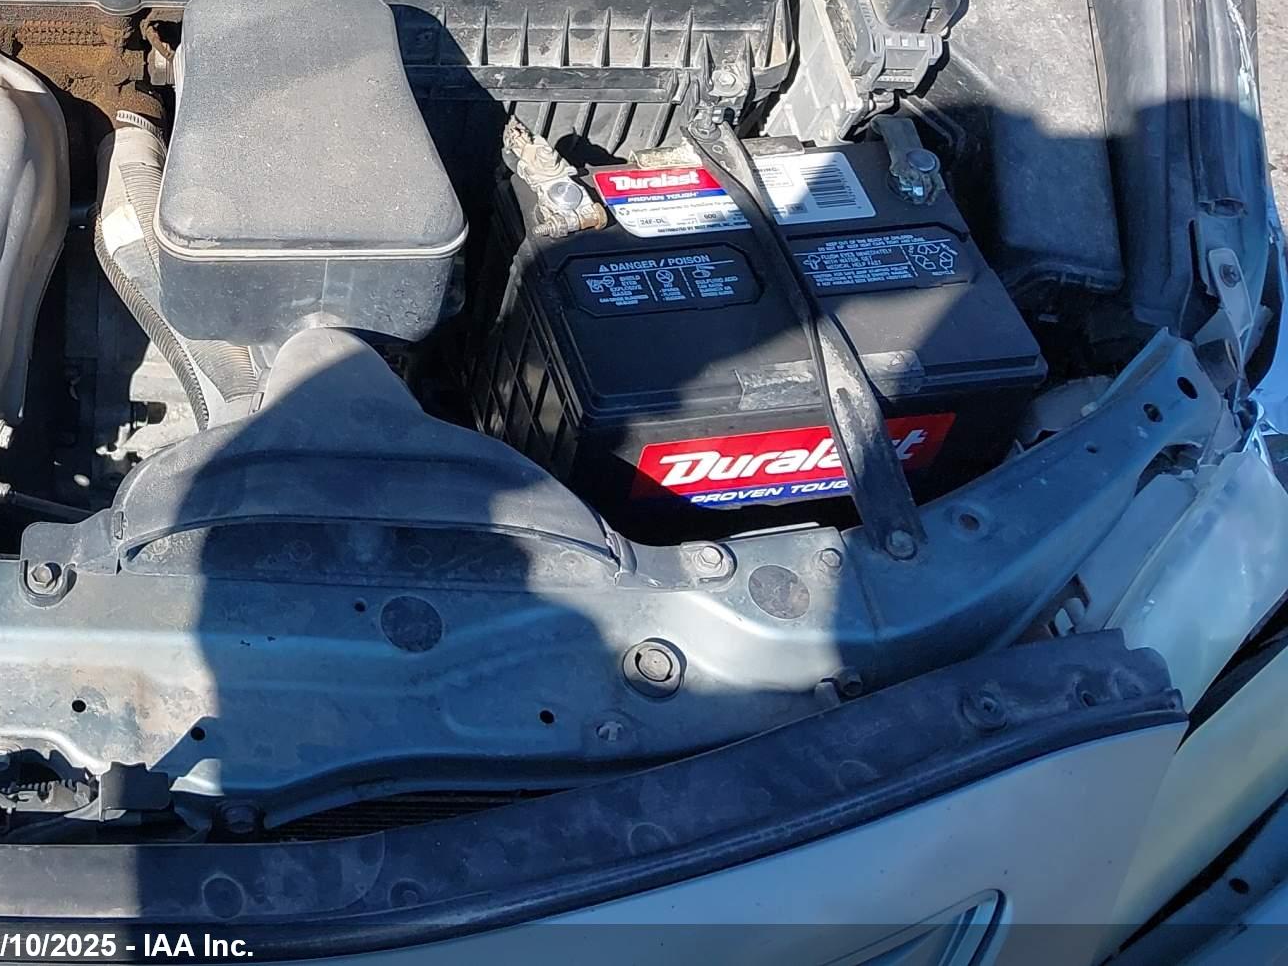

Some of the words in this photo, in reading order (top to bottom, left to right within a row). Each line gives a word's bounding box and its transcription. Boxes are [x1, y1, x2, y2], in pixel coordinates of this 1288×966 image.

[609, 170, 701, 191] Duralast
[628, 194, 665, 203] PROVEN
[666, 192, 697, 200] TOUGH
[610, 259, 658, 271] DANGER
[668, 254, 711, 266] POISON
[659, 430, 927, 486] Duralat
[691, 487, 784, 503] PROVEN
[791, 480, 848, 493] TOUG
